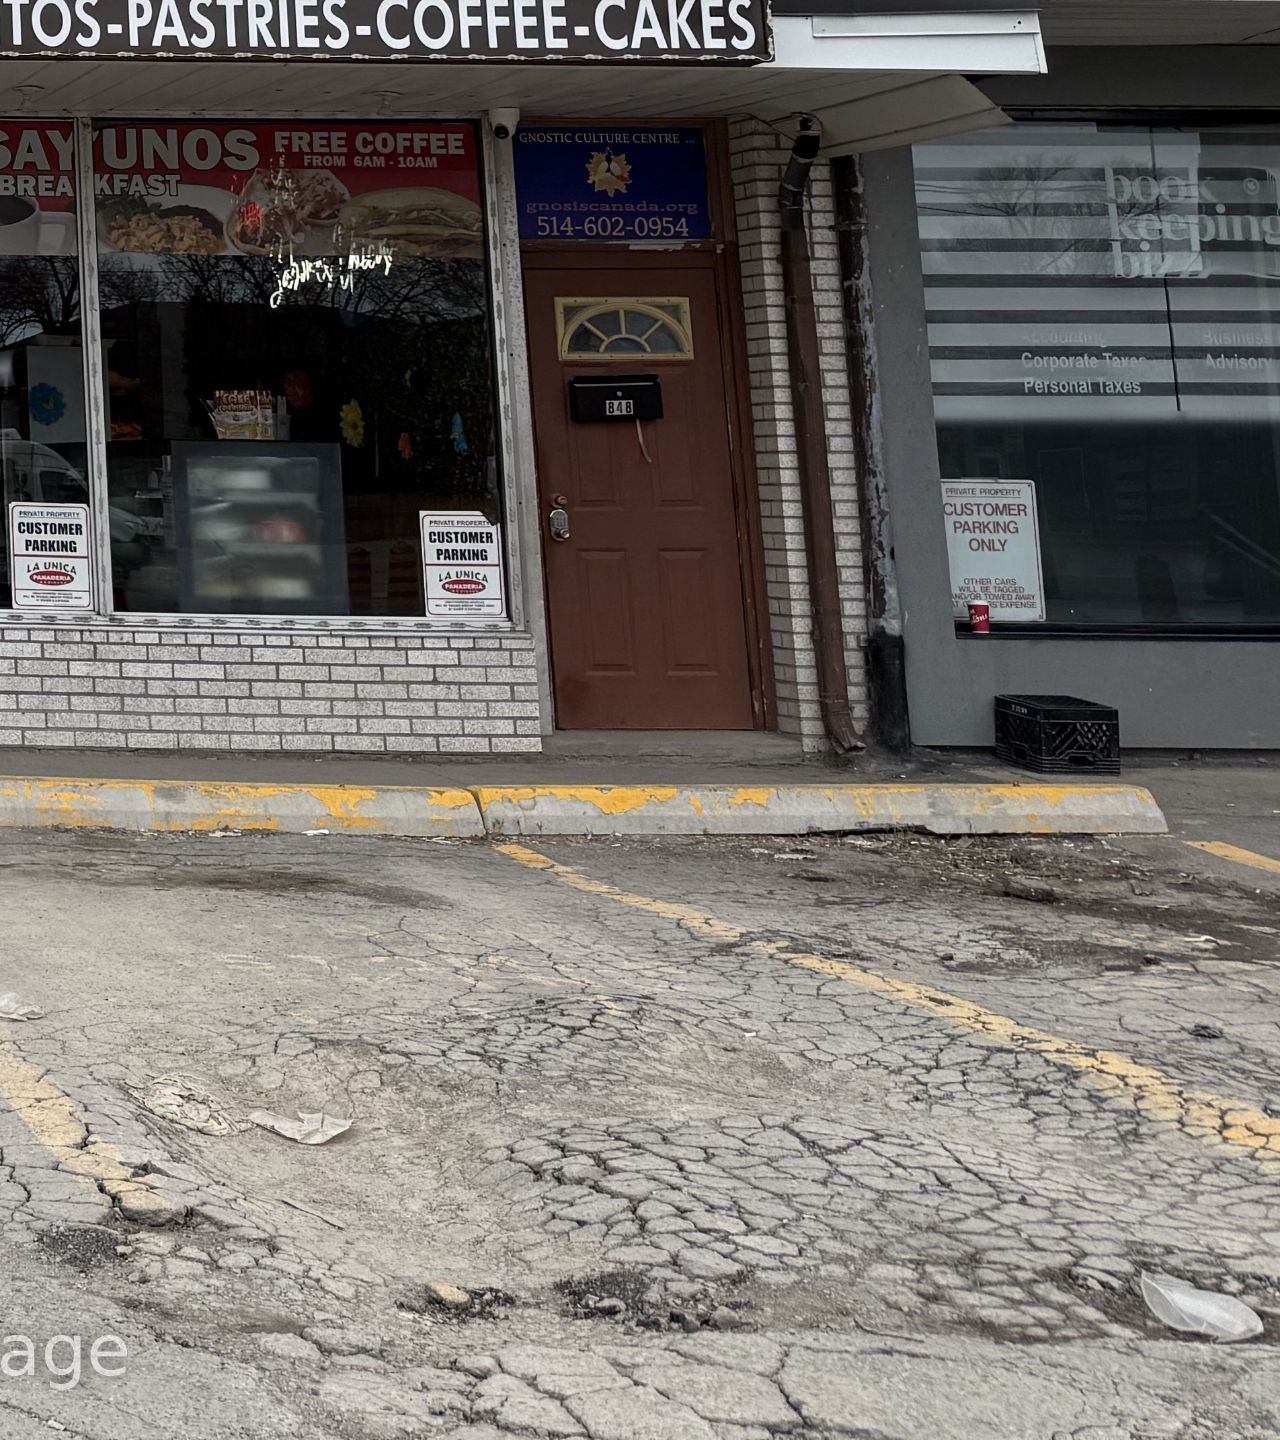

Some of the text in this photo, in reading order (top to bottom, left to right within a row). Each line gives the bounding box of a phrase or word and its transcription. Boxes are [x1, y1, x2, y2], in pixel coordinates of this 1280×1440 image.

[274, 131, 465, 155] FREE COFFEE
[519, 133, 680, 144] GNOSTIC CULTURE CENTRE
[303, 156, 438, 168] FROM 6AM 10AM
[526, 201, 698, 214] gnosiscanada.org
[537, 216, 689, 237] 514-602-0954
[1021, 352, 1147, 371] Corporate Taxes
[1204, 354, 1273, 371] Advisory
[1024, 377, 1142, 394] Personal Taxes
[608, 401, 632, 414] 848
[946, 488, 1022, 496] PRIVATE PROPERTY
[943, 503, 1028, 516] CUSTOMER
[18, 522, 82, 536] CUSTOMER
[954, 521, 1019, 534] PARKING
[428, 532, 494, 544] CUSTOMER
[24, 539, 78, 552] PARKING
[968, 538, 1008, 552] ONLY
[436, 548, 488, 561] PARKING
[26, 562, 76, 575] LA UNICA
[438, 570, 488, 583] LA UNICA
[964, 578, 1017, 586] OTHER CARS
[993, 586, 1024, 594] TAGGED
[1000, 601, 1038, 609] EXPENSE
